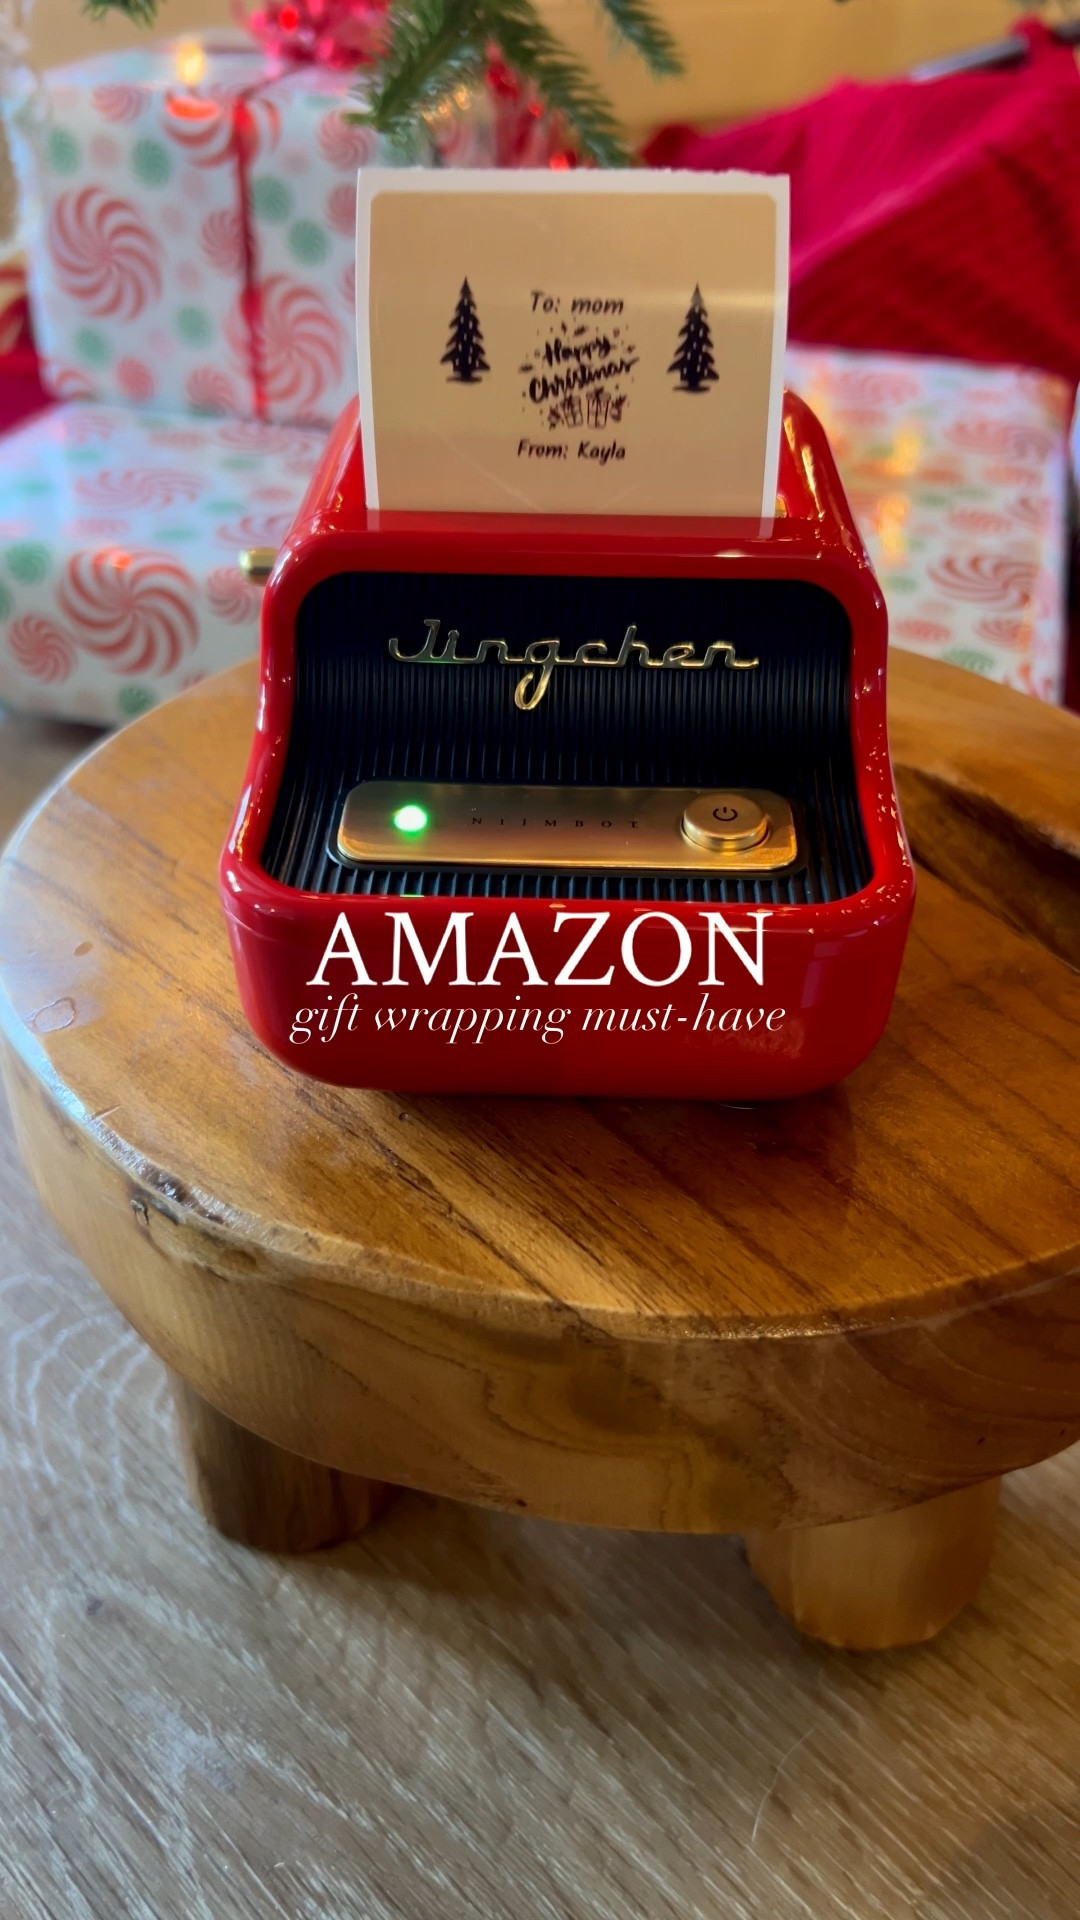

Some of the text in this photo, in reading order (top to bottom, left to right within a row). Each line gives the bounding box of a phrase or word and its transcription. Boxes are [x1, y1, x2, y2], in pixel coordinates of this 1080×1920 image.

[530, 290, 624, 315] To: mom
[543, 335, 611, 366] Happy
[528, 356, 640, 404] Christmas
[517, 438, 626, 466] From: Kayla
[388, 618, 760, 711] Jingchen
